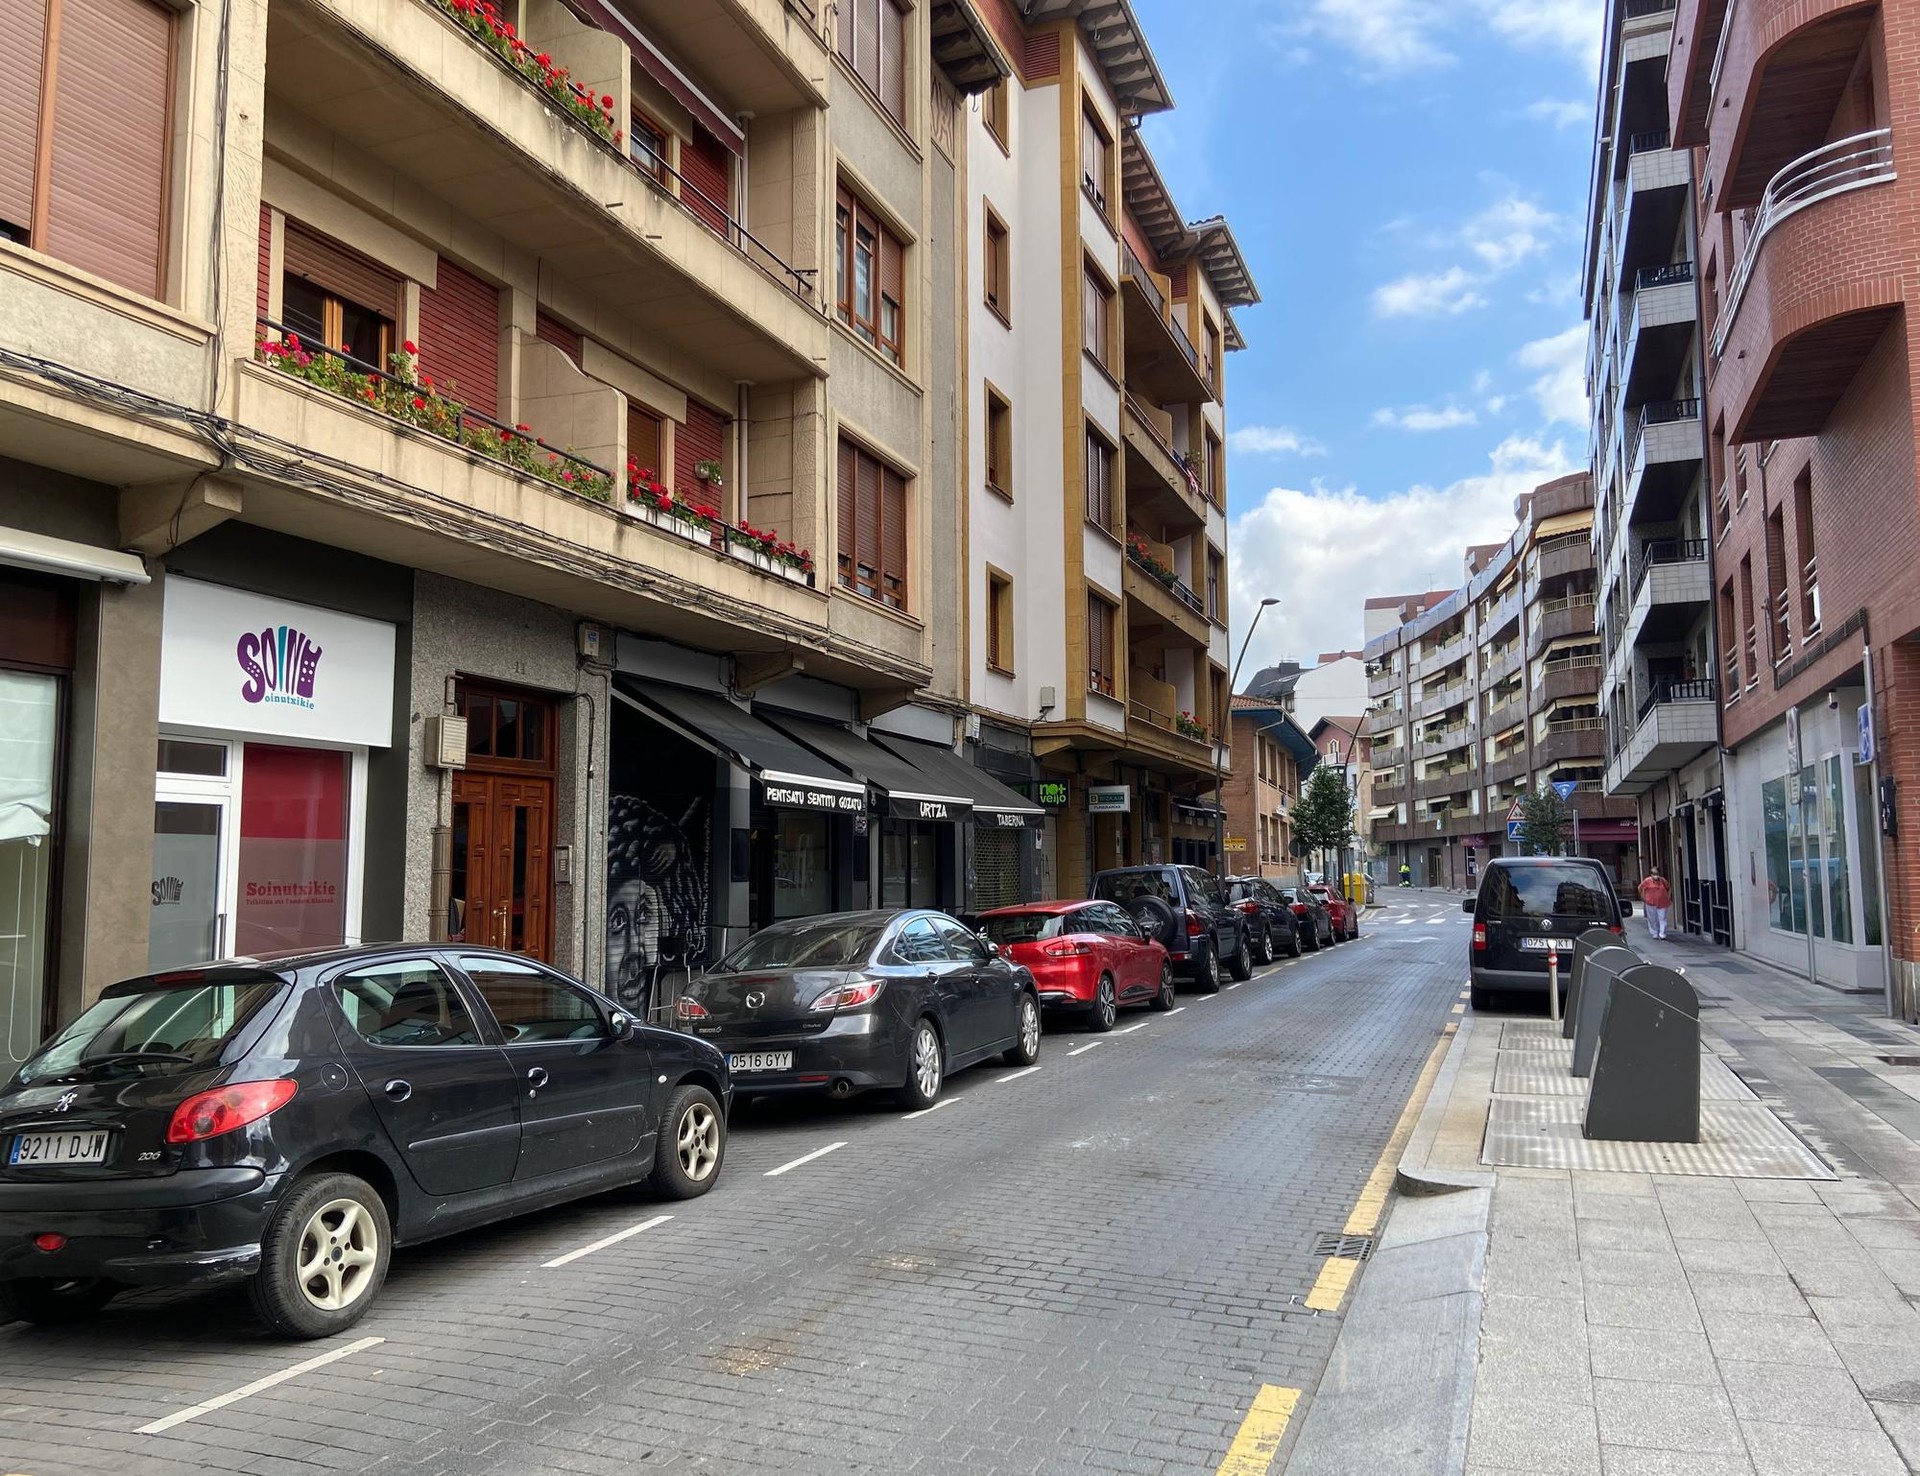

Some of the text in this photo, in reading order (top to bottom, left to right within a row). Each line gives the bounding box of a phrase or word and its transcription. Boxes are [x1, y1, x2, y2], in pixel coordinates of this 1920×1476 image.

[766, 786, 862, 811] PENTSATU SENTITU GOZATU
[919, 801, 948, 819] URTZA
[996, 813, 1026, 828] TABERNA
[246, 881, 336, 897] Soinutxikie
[1528, 938, 1551, 948] 075
[731, 1053, 789, 1069] 0516 GYY
[20, 1134, 106, 1160] 9211 DJW
[138, 1150, 162, 1161] 206
